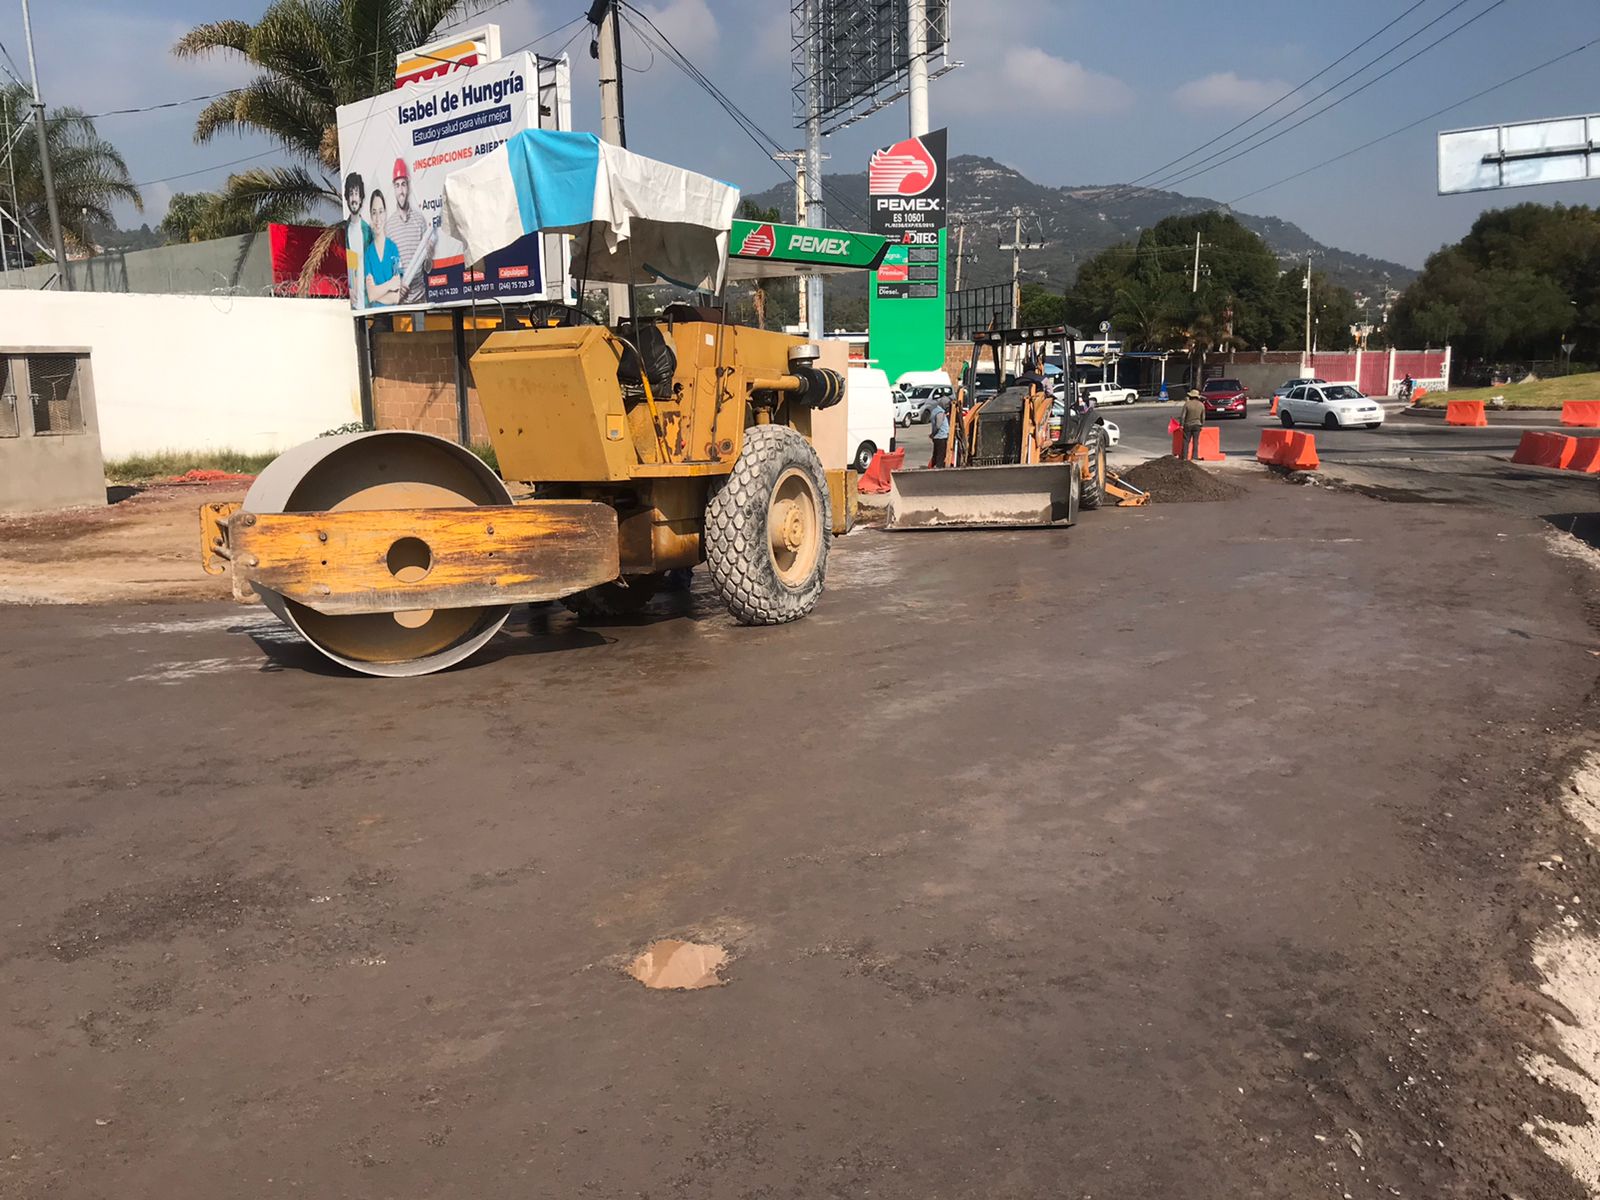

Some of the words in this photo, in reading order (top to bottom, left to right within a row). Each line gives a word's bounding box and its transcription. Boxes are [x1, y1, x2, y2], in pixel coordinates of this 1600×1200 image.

[398, 95, 438, 124] Isabel
[441, 91, 459, 113] de
[462, 71, 524, 106] Hungría
[414, 129, 436, 142] Estudio
[441, 122, 459, 136] salud
[459, 119, 473, 132] para
[473, 114, 488, 125] vivir
[488, 110, 510, 123] mejor
[877, 198, 940, 211] PEMEX
[893, 213, 902, 222] ES
[904, 213, 925, 222] 10501
[788, 235, 850, 256] PEMEX
